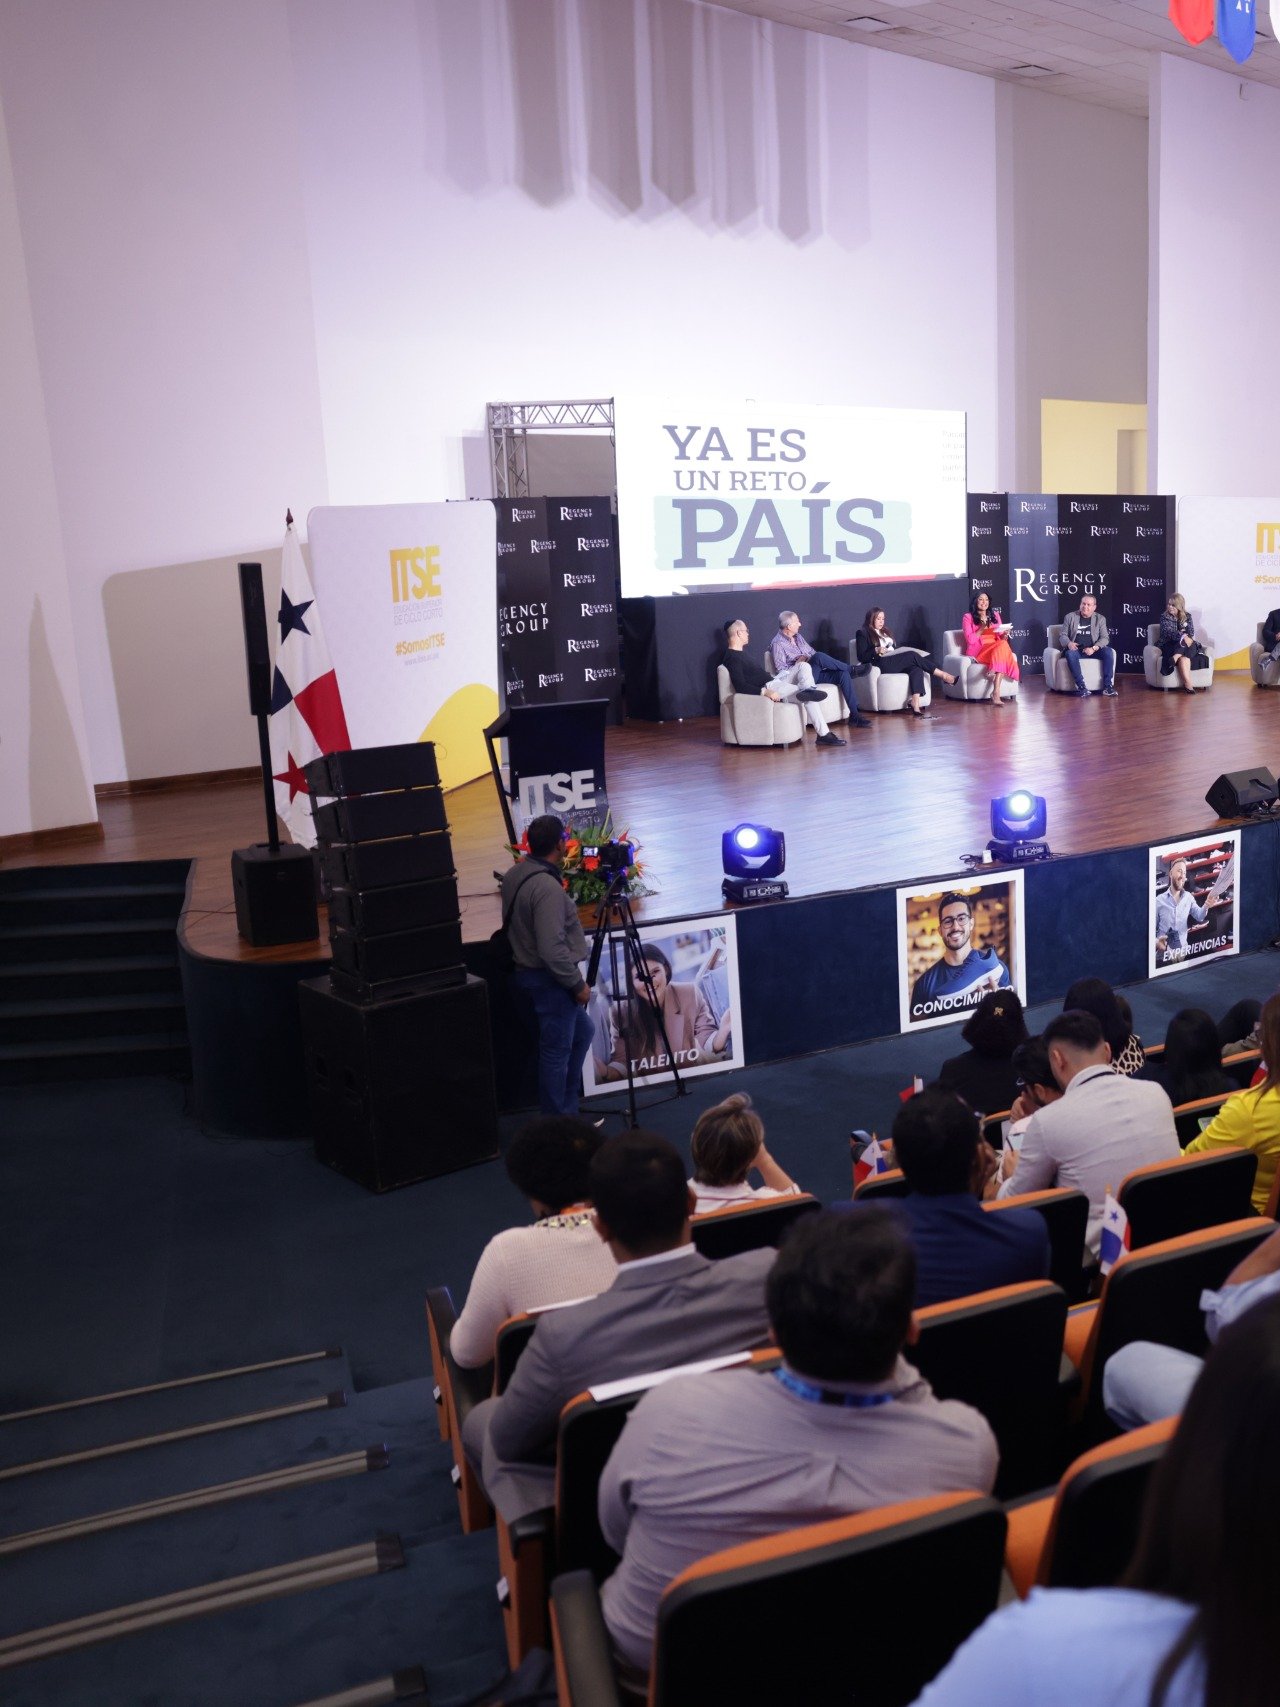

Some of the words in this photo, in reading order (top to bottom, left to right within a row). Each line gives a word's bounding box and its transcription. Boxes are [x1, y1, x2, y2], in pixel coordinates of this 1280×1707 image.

[662, 425, 733, 461] YA
[747, 428, 807, 462] ES
[674, 470, 720, 490] UN
[729, 471, 807, 491] RETO
[672, 482, 885, 568] PAÍS
[389, 545, 441, 603] ITSE
[1014, 568, 1106, 602] REGENCY
[1039, 585, 1106, 594] GROUP
[394, 615, 403, 626] DE
[423, 607, 443, 621] CORTO
[499, 603, 547, 621] EGENCY
[500, 618, 548, 636] GROUP
[396, 632, 445, 656] #SomosITSE
[518, 768, 597, 817] ITSE
[1162, 935, 1227, 962] EXPERIENCIAS
[913, 985, 1014, 1016] CONOCIMI
